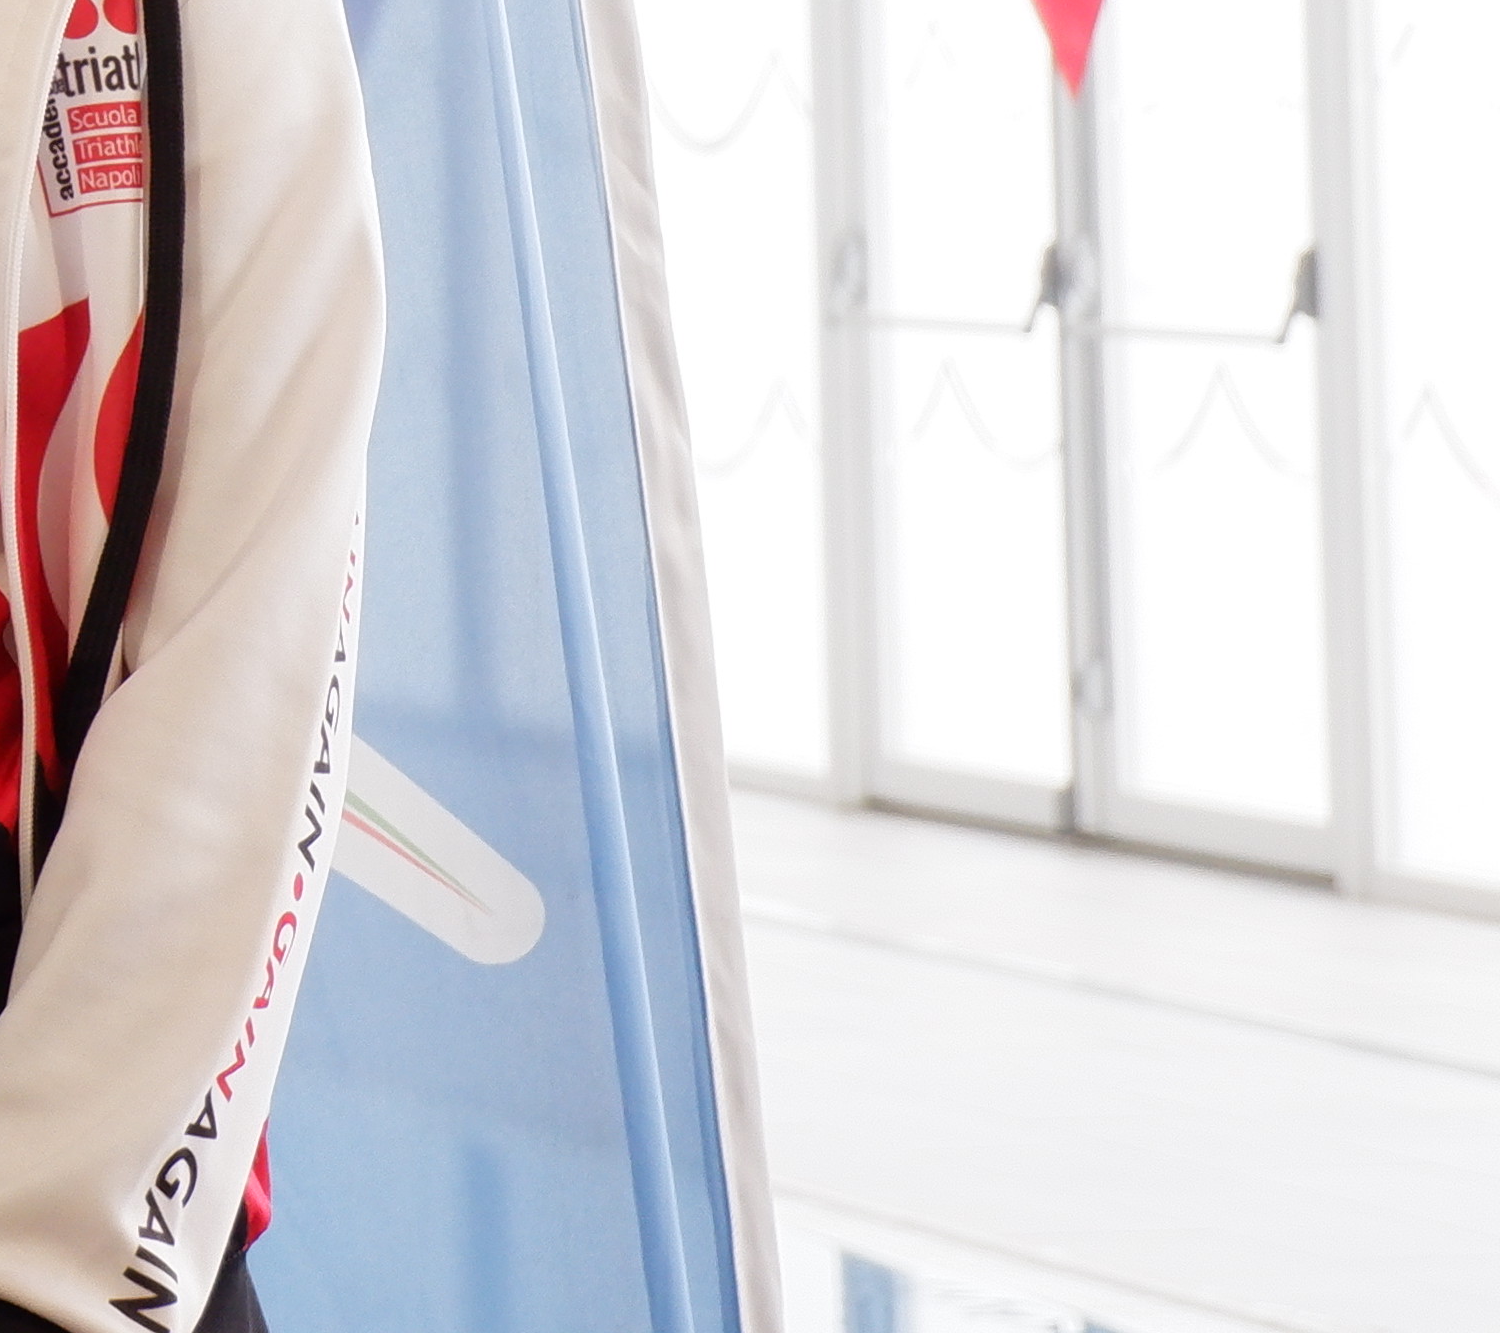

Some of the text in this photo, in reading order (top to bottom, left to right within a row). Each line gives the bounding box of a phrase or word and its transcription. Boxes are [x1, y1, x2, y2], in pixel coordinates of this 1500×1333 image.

[57, 41, 140, 97] triat
[70, 106, 138, 131] Scuola
[80, 164, 141, 191] Napoli
